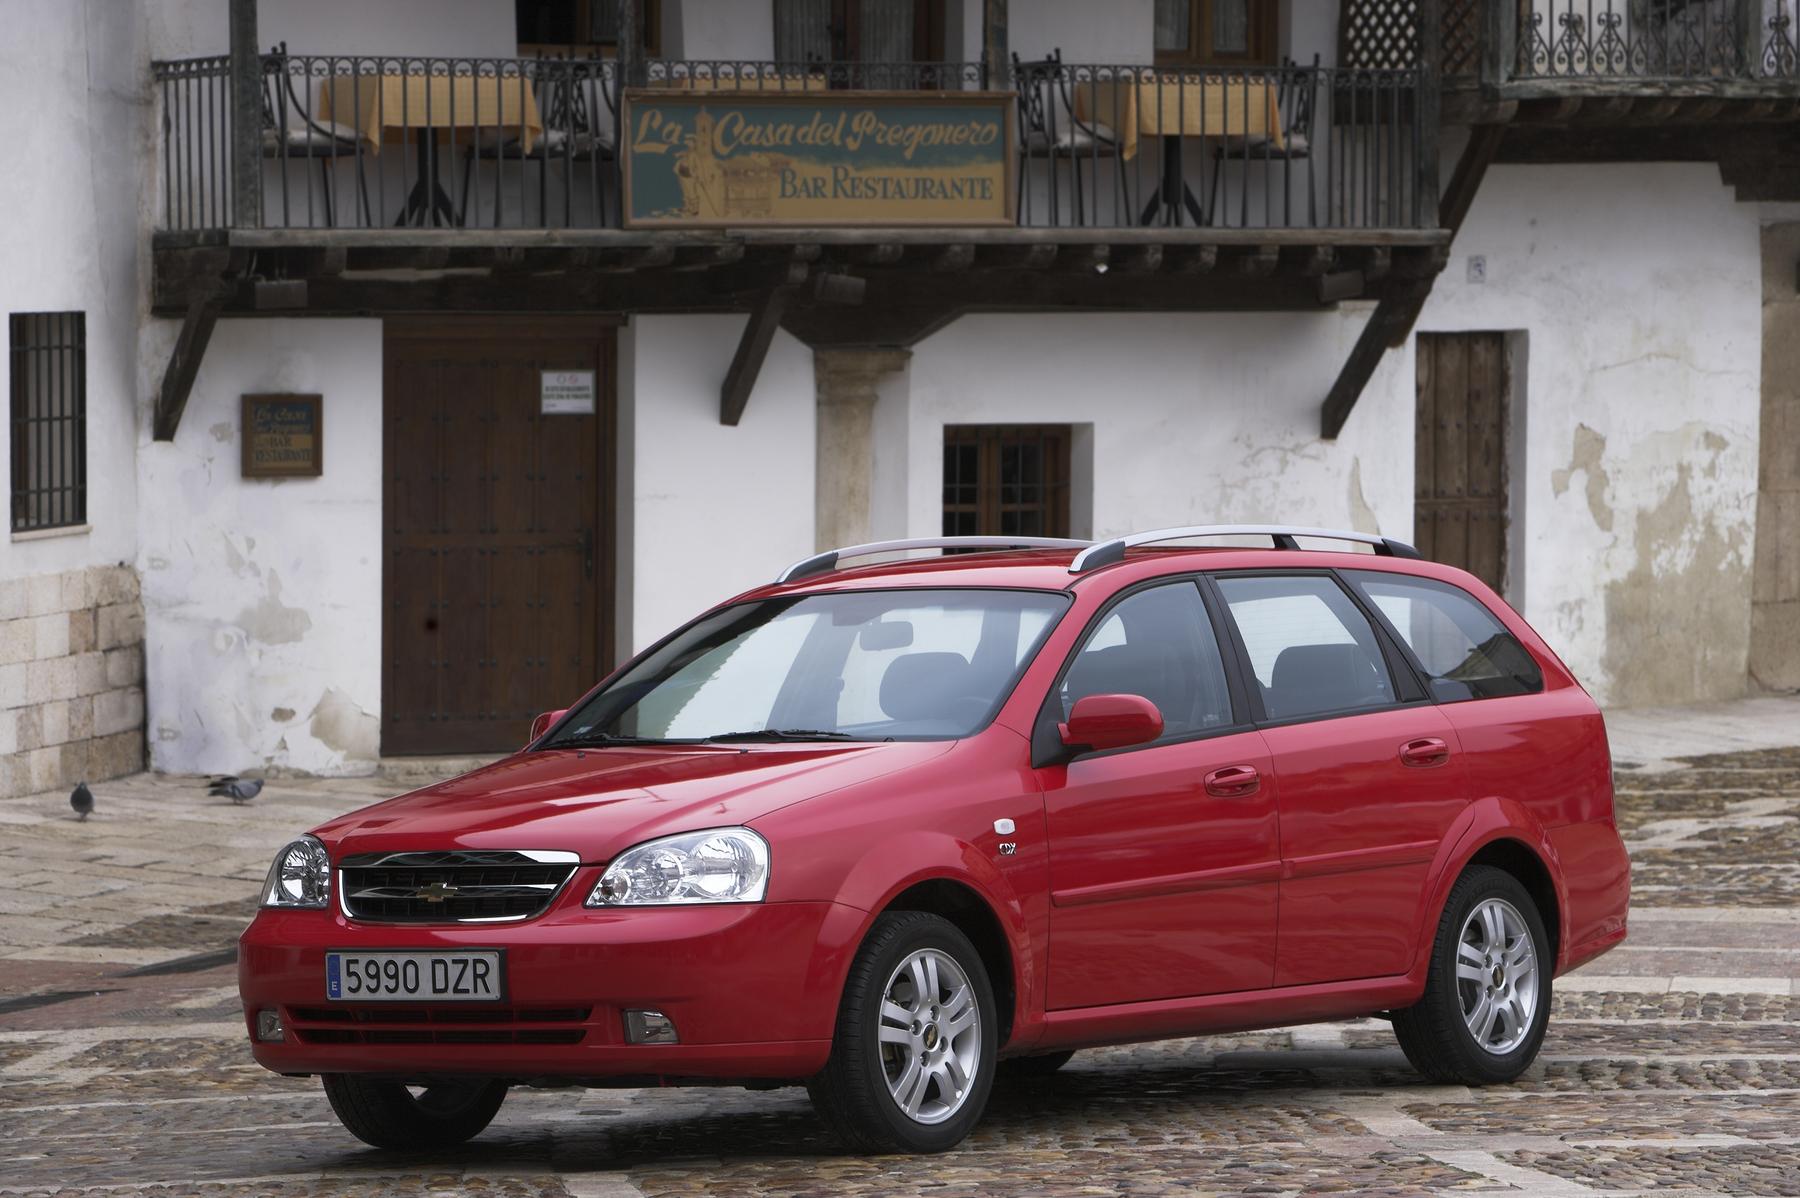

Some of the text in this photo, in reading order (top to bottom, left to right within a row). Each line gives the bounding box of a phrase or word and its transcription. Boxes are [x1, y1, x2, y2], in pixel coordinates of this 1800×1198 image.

[633, 109, 999, 160] La Casa del Pregonero
[332, 981, 338, 992] E
[345, 958, 491, 994] 5990 DZR
